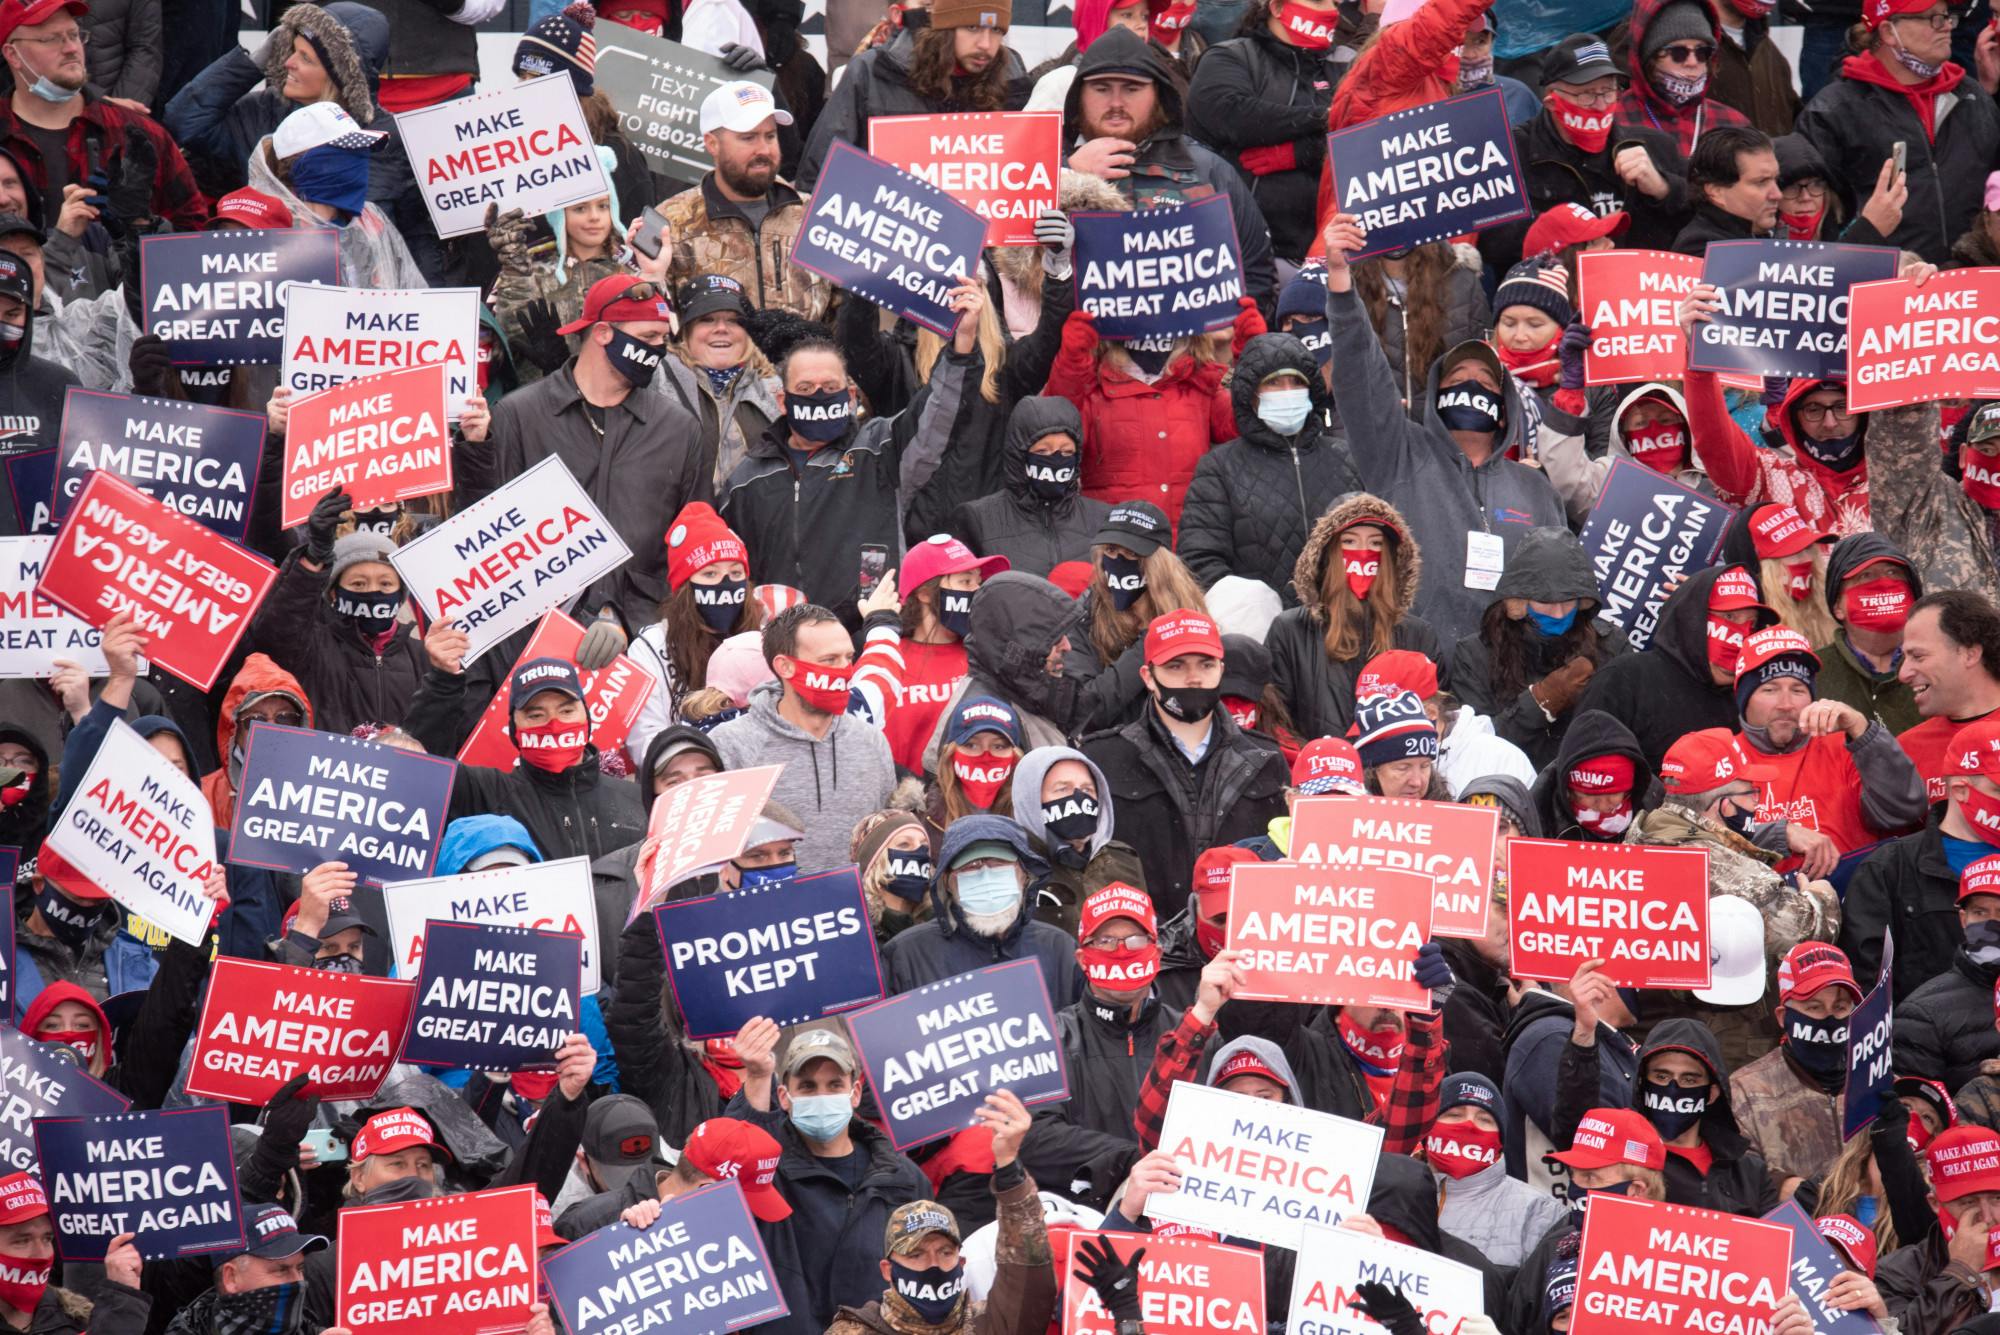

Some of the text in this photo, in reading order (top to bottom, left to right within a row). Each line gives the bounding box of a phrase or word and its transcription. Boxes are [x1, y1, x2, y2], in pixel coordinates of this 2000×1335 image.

[520, 55, 553, 69] TRUMP
[649, 73, 700, 100] TEXT
[637, 95, 698, 124] FIGHT
[454, 109, 524, 142] MAKE
[618, 114, 706, 152] TO 88022
[427, 123, 582, 185] AMERICA
[929, 133, 1005, 156] MAKE
[1381, 124, 1452, 159] MAKE
[434, 155, 592, 211] GREAT AGAIN
[1345, 140, 1508, 207] AMERICA
[875, 184, 943, 232] MAKE
[1353, 177, 1516, 233] GREAT AGAIN
[807, 224, 890, 275] GREAT
[816, 194, 967, 278] AMERICA
[1124, 224, 1195, 254] MAKE
[202, 252, 278, 274] MAKE
[1082, 244, 1236, 290] AMERICA
[1758, 262, 1835, 287] MAKE
[1083, 278, 1242, 319] GREAT AGAIN
[1711, 290, 1849, 324] AMERIC
[1904, 291, 1978, 315] MAKE
[153, 319, 240, 341] GREAT
[346, 312, 420, 331] MAKE
[293, 335, 466, 368] AMERICA
[1592, 334, 1678, 358] GREAT
[1702, 325, 1791, 350] GREAT
[1857, 355, 1932, 385] GREAT
[329, 393, 394, 427] MAKE
[793, 402, 851, 422] MAGA
[1437, 393, 1499, 418] MAGA
[125, 418, 203, 447] MAKE
[291, 412, 439, 473] AMERICA
[1628, 432, 1686, 454] MAGA
[68, 440, 246, 492] AMERICA
[289, 447, 441, 499] GREAT AGAIN
[1026, 463, 1076, 484] MAGA
[161, 492, 244, 521] AGAIN
[1126, 509, 1157, 524] AMERICA
[454, 506, 526, 561] MAKE
[1130, 517, 1153, 530] AGAIN
[1758, 513, 1785, 535] MAKE
[1771, 521, 1798, 543] GREAT
[83, 497, 252, 605] GREAT AGAIN
[1660, 501, 1712, 580] AGAIN
[435, 505, 591, 616] AMERICA
[74, 524, 239, 635] AMERICA
[452, 528, 608, 634] GREAT AGAIN
[1717, 585, 1746, 596] GREAT
[98, 584, 173, 640] MAKE
[337, 598, 399, 620] MAGA
[1860, 594, 1905, 607] TRUMP
[1156, 620, 1211, 634] MAKE AMERICA
[1161, 626, 1210, 641] GREAT AGAIN
[1748, 630, 1779, 646] MAKE
[1755, 643, 1780, 656] GREAT
[518, 667, 571, 684] TRUMP
[961, 704, 1011, 722] TRUMP
[521, 733, 586, 749] MAGA
[309, 756, 389, 791] MAKE
[1307, 755, 1356, 773] Trump
[1714, 756, 1734, 778] 45
[1960, 751, 1980, 769] 45
[1570, 770, 1614, 786] TRUMP
[141, 776, 196, 829] MAKE
[248, 778, 432, 840] AMERICA
[1042, 799, 1098, 824] MAGA
[86, 778, 214, 883] AMERICA
[243, 816, 428, 870] GREAT AGAIN
[1353, 819, 1432, 845] MAKE
[72, 808, 203, 918] GREAT AGAIN
[1965, 862, 1986, 880] MAKE
[1567, 865, 1644, 892] MAKE
[1967, 874, 1993, 890] GREAT
[452, 892, 529, 920] MAKE
[1088, 886, 1149, 908] MAKE AMERICA
[1092, 899, 1146, 917] GREAT AGAIN
[1295, 885, 1376, 910] MAKE
[1518, 893, 1699, 933] AMERICA
[671, 907, 861, 970] PROMISES
[1238, 913, 1424, 951] AMERICA
[474, 950, 537, 976] MAKE
[1237, 949, 1329, 972] GREAT
[1518, 935, 1700, 962] GREAT AGAIN
[725, 952, 820, 998] KEPT
[1089, 961, 1154, 982] MAGA
[272, 989, 355, 1020] MAKE
[422, 978, 574, 1020] AMERICA
[1096, 1006, 1114, 1021] HH
[916, 993, 999, 1035] MAKE
[209, 1013, 390, 1057] AMERICA
[416, 1016, 572, 1049] GREAT AGAIN
[882, 1012, 1052, 1092] AMERICA
[202, 1051, 386, 1084] GREAT AGAIN
[1222, 1058, 1247, 1076] GREAT
[890, 1050, 1059, 1121] GREAT AGAIN
[1460, 1082, 1494, 1099] Trump
[1643, 1091, 1705, 1114] MAGA
[374, 1113, 401, 1129] MAKE
[381, 1125, 412, 1140] GREAT
[1232, 1118, 1313, 1153] MAKE
[86, 1135, 165, 1163] MAKE
[1426, 1134, 1499, 1164] MAGA
[1935, 1139, 2000, 1162] MAKE AMERICA
[715, 1159, 743, 1181] 45
[1173, 1136, 1355, 1204] AMERICA
[1943, 1156, 2000, 1177] GREAT AGAIN
[54, 1161, 227, 1203] AMERICA
[6, 1193, 38, 1210] GREAT
[58, 1212, 132, 1236] GREAT
[137, 1201, 232, 1234] AGAIN
[903, 1211, 949, 1224] Trump
[1819, 1217, 1866, 1243] Trump
[402, 1218, 477, 1249] MAKE
[608, 1221, 690, 1271] MAKE
[1649, 1227, 1730, 1261] MAKE
[1822, 1229, 1856, 1246] 2020
[349, 1245, 528, 1294] AMERICA
[576, 1235, 757, 1331] AMERICA
[1137, 1260, 1210, 1288] MAKE
[1358, 1259, 1430, 1296] MAKE
[1588, 1251, 1777, 1310] AMERICA
[682, 1270, 768, 1315] AGAIN
[897, 1277, 964, 1300] MAGA
[347, 1283, 530, 1326] GREAT AGAIN
[1074, 1288, 1259, 1335] AERICA
[1584, 1291, 1775, 1335] GREAT AGAIN
